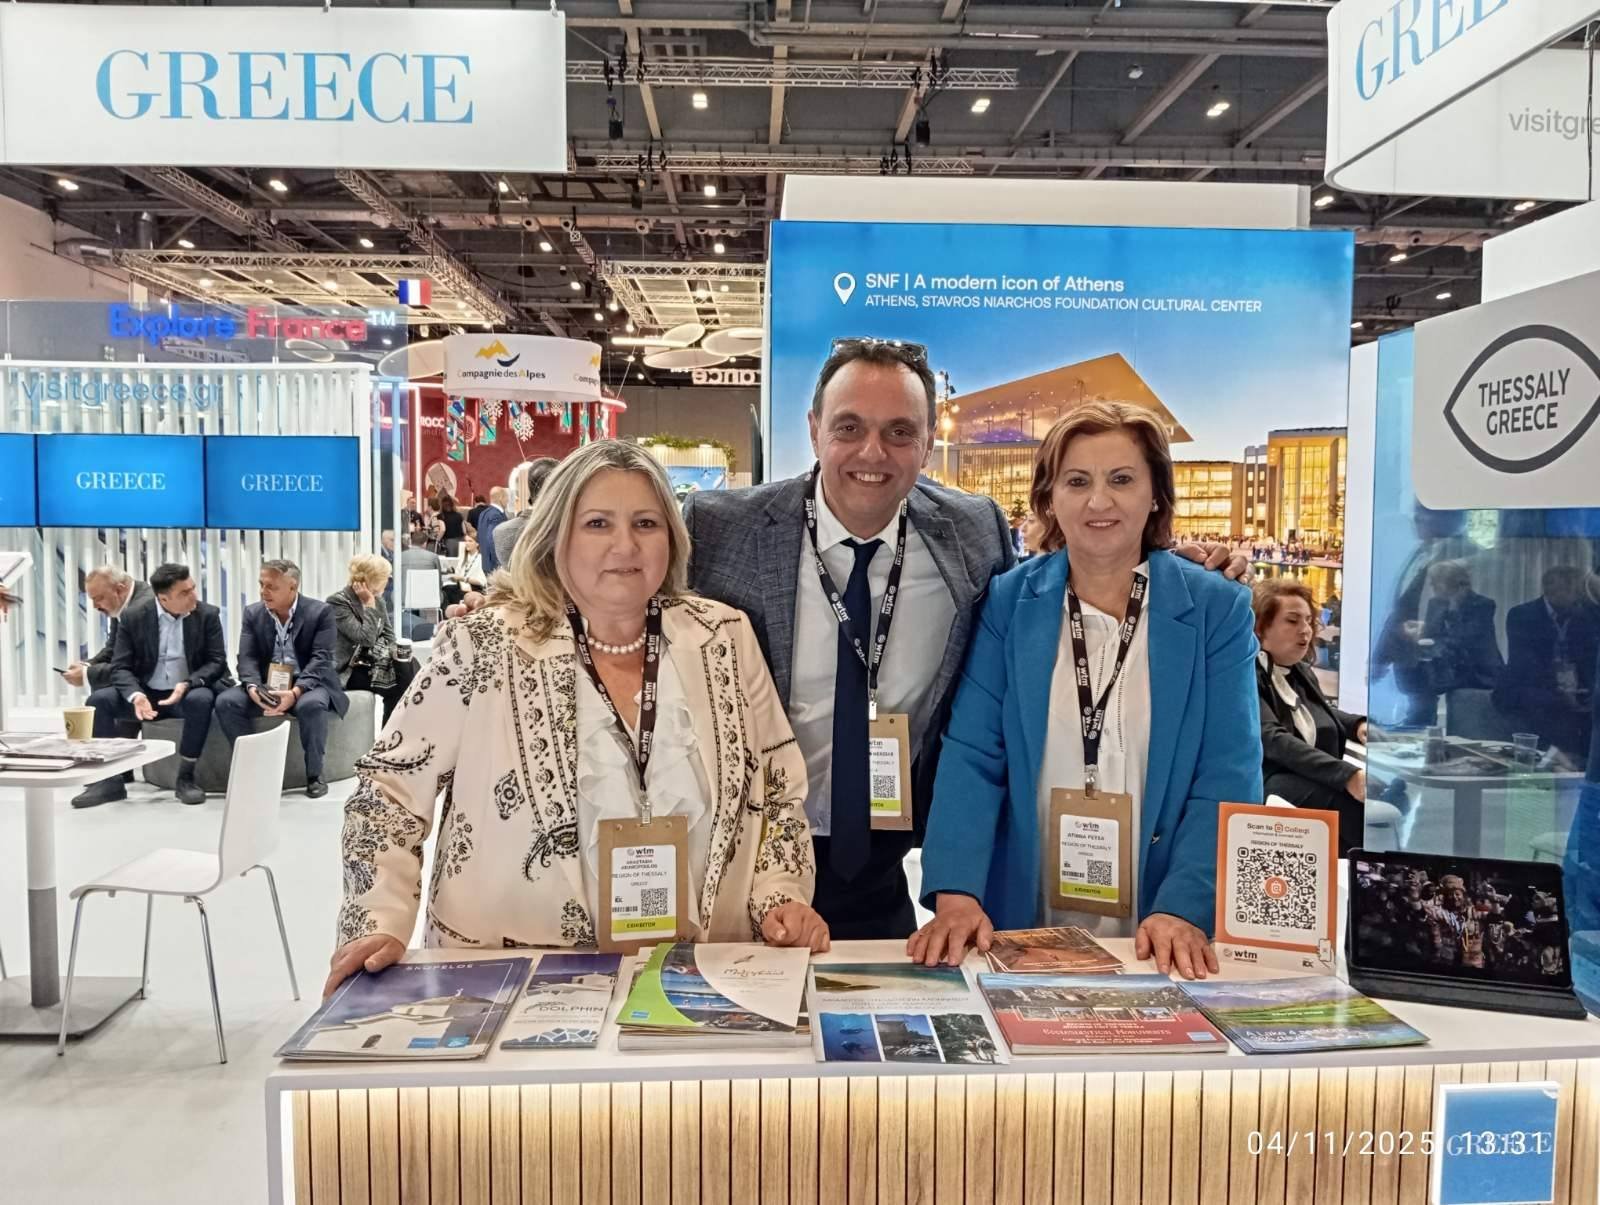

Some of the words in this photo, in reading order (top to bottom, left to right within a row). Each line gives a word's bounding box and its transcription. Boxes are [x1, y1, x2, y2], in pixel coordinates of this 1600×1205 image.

[96, 50, 473, 124] GREECE
[866, 274, 899, 289] SNF
[914, 275, 927, 290] A
[931, 275, 997, 291] modern
[1002, 275, 1037, 291] icon
[1041, 276, 1061, 291] of
[1065, 276, 1124, 292] Athens
[865, 295, 919, 309] ATHENS,
[922, 296, 980, 308] STAVROS
[983, 297, 1051, 309] NIARCHOS
[1055, 298, 1138, 310] FOUNDATION
[1142, 299, 1207, 311] CULTURAL
[1211, 300, 1262, 312] CENTER
[108, 304, 236, 346] Explore
[21, 376, 223, 408] visitgreece.gr
[1478, 368, 1570, 407] THESSALY
[1486, 402, 1558, 436] GREECE
[76, 471, 166, 490] GREECE
[241, 474, 323, 492] GREECE
[1135, 581, 1144, 600] wtm
[836, 601, 850, 621] wtm
[886, 595, 894, 615] wtm
[1075, 620, 1083, 639] wtm
[1122, 624, 1134, 645] wtm
[648, 634, 656, 653] wtm
[874, 642, 884, 664] wtm
[1079, 666, 1089, 686] wtm
[602, 693, 616, 713] wtm
[642, 731, 650, 752] wtm
[1234, 950, 1257, 959] wtm
